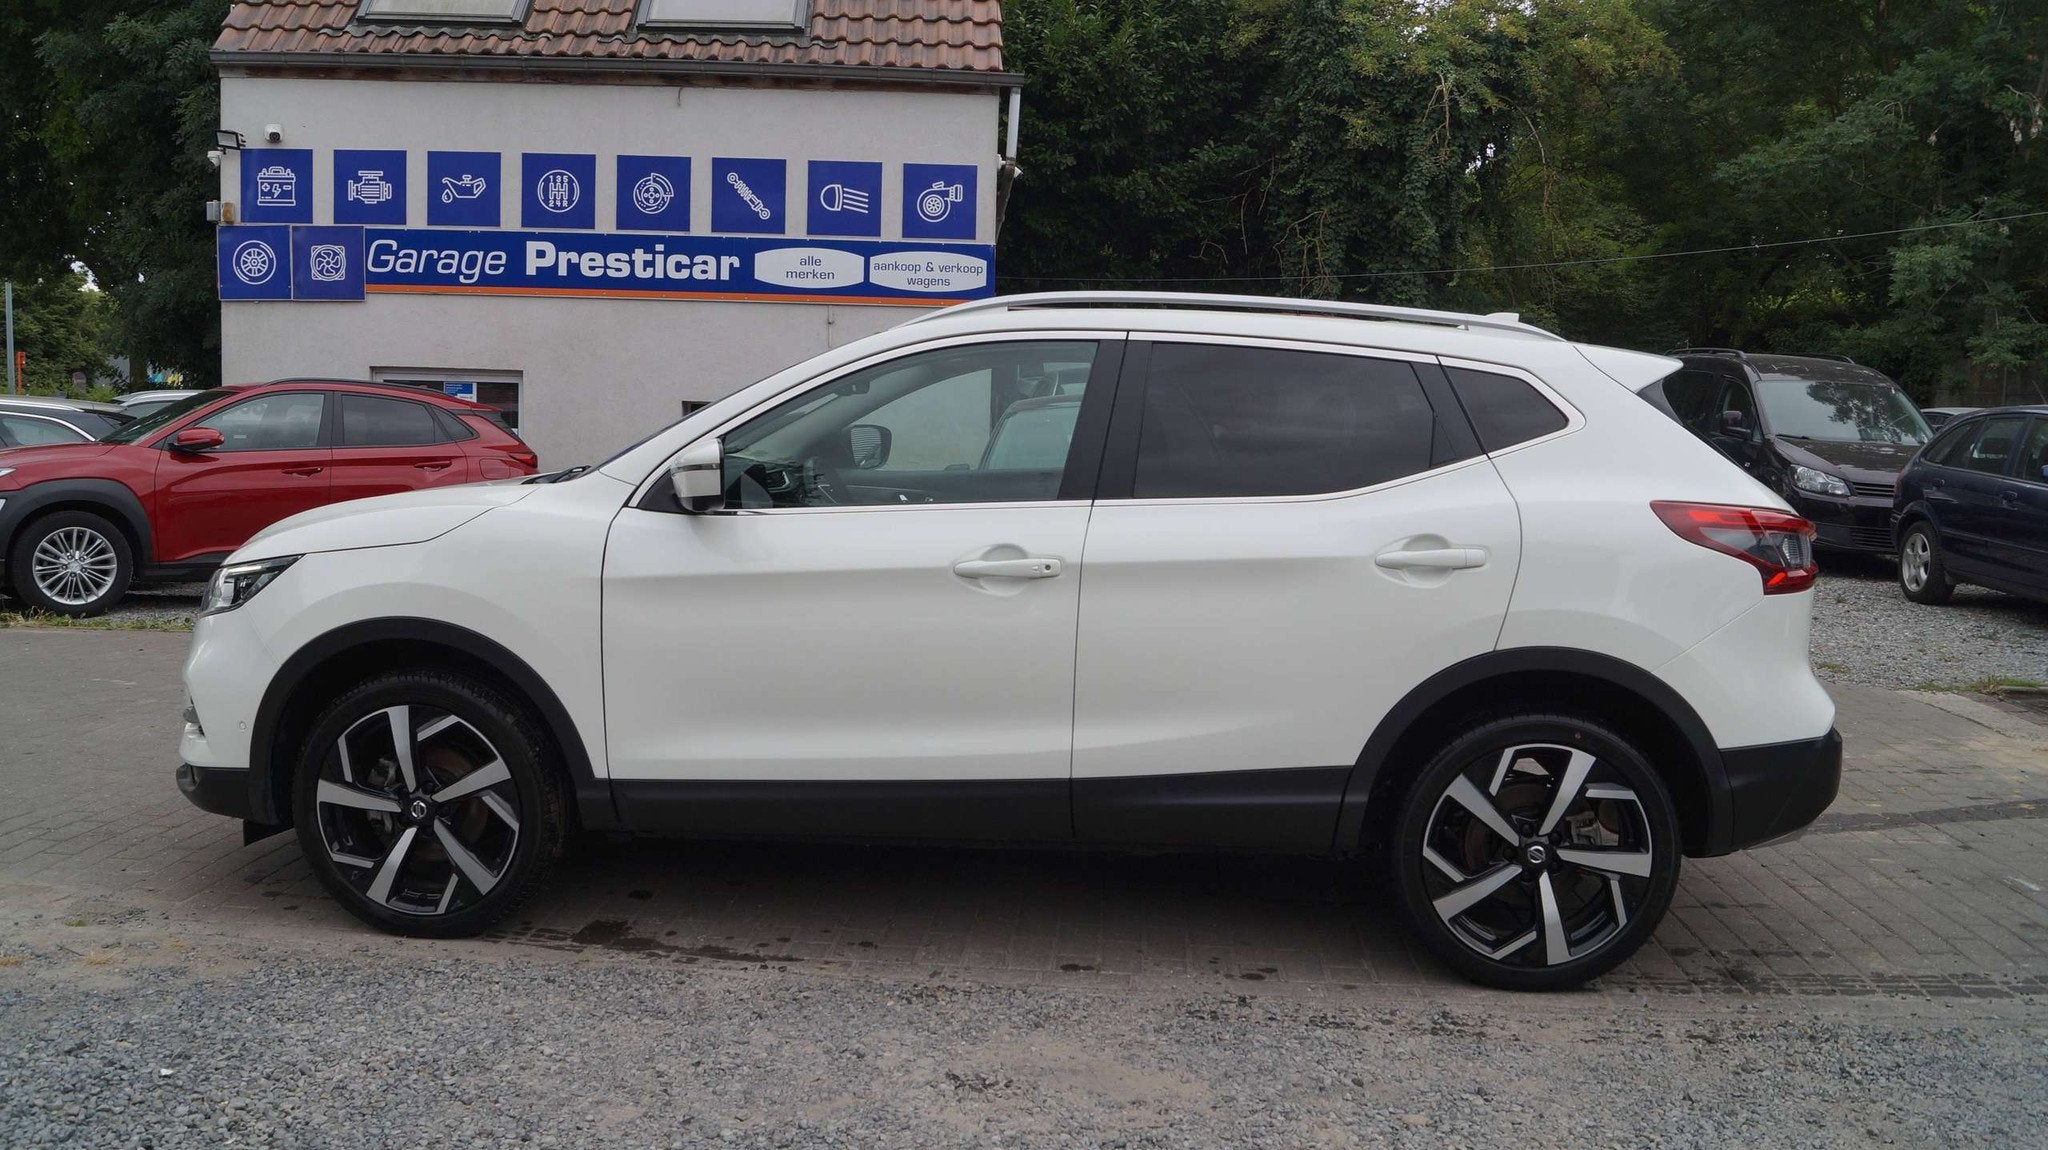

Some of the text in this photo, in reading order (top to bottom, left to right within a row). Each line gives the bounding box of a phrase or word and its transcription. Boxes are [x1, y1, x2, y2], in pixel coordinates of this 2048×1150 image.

[367, 239, 740, 284] Garage Presticar
[799, 255, 822, 267] alle
[785, 269, 835, 280] merken
[873, 261, 984, 276] aankoop & verkoop
[906, 277, 951, 288] wagens
